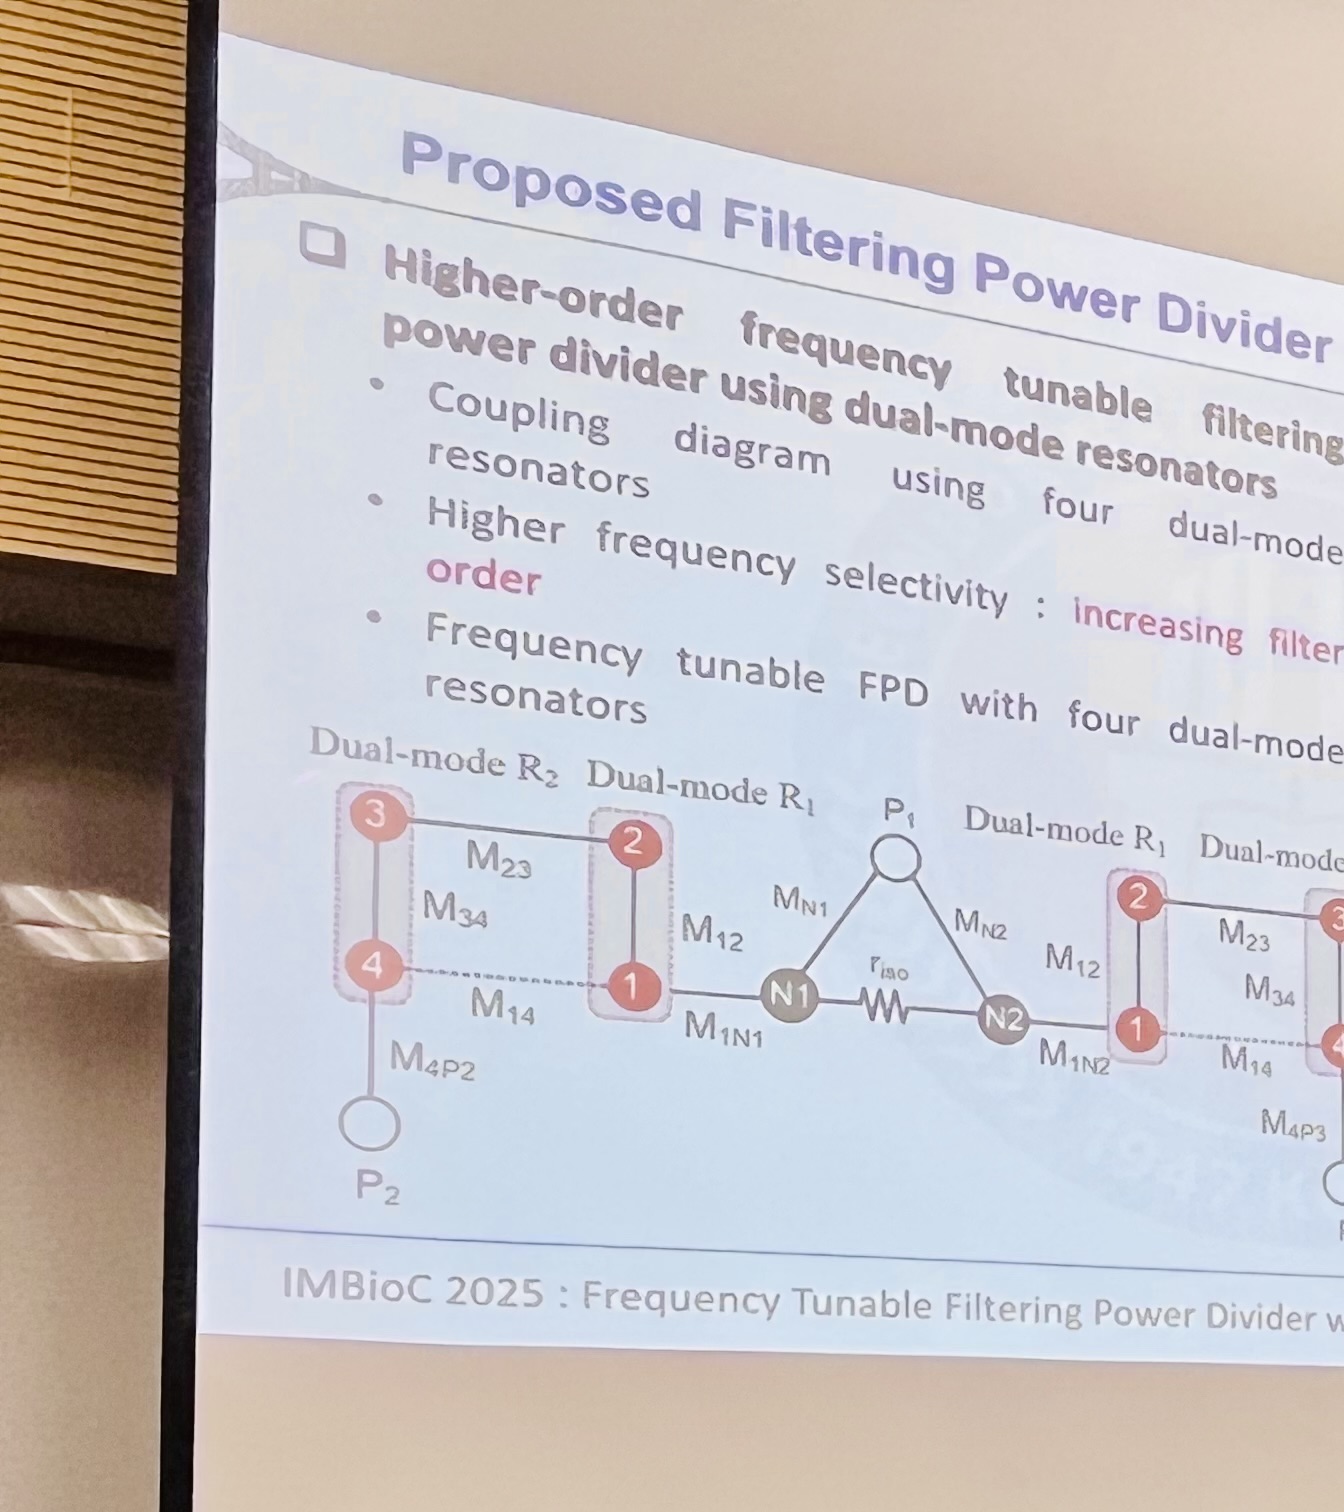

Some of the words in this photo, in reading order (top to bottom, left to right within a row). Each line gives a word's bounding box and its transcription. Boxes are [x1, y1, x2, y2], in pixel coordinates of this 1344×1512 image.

[402, 130, 701, 231] Proposed
[723, 197, 954, 295] Filtering
[975, 252, 1141, 324] Power
[1158, 292, 1333, 363] Divider
[384, 243, 684, 331] Higher-order
[740, 310, 952, 390] frequency
[1003, 366, 1152, 423] tunable
[1202, 402, 1344, 466] filtering
[383, 311, 536, 365] power
[550, 336, 709, 394] divider
[720, 371, 833, 425] using
[845, 388, 1066, 461] dual-mode
[1077, 438, 1278, 500] resonators
[428, 441, 650, 498] resonators
[429, 380, 611, 446] Coupling
[675, 422, 831, 477] diagram
[892, 465, 985, 510] using
[1042, 486, 1114, 525] four
[1169, 511, 1344, 566] dual-mode
[427, 557, 542, 596] order
[428, 496, 566, 545] Higher
[597, 521, 796, 585] frequency
[825, 560, 1008, 619] selectivity
[1037, 596, 1045, 619] :
[1074, 597, 1243, 657] increasing
[1269, 627, 1344, 666] filter
[426, 673, 648, 725] resonators
[427, 612, 643, 676] Frequency
[677, 647, 825, 694] tunable
[860, 671, 929, 707] FPD
[961, 690, 1038, 723] with
[1068, 699, 1141, 736] four
[1169, 715, 1344, 765] dual-mode
[309, 726, 506, 777] Dual-mode
[587, 758, 768, 807] Dual-mode
[365, 796, 386, 828] 3
[965, 804, 1124, 847] Dual-mode
[623, 827, 644, 855] 2
[1130, 888, 1148, 908] 2
[361, 950, 383, 979] 4
[623, 973, 638, 999] 1
[769, 986, 810, 1009] N1
[985, 1007, 1023, 1031] N2
[1131, 1018, 1144, 1040] 1
[283, 1266, 432, 1305] IMBioC
[446, 1276, 544, 1308] 2025
[559, 1285, 568, 1310] :
[583, 1280, 780, 1322] Frequency
[792, 1286, 932, 1321] Tunable
[945, 1291, 1082, 1331] Filtering
[1094, 1299, 1196, 1330] Power
[1207, 1301, 1317, 1333] Divider
